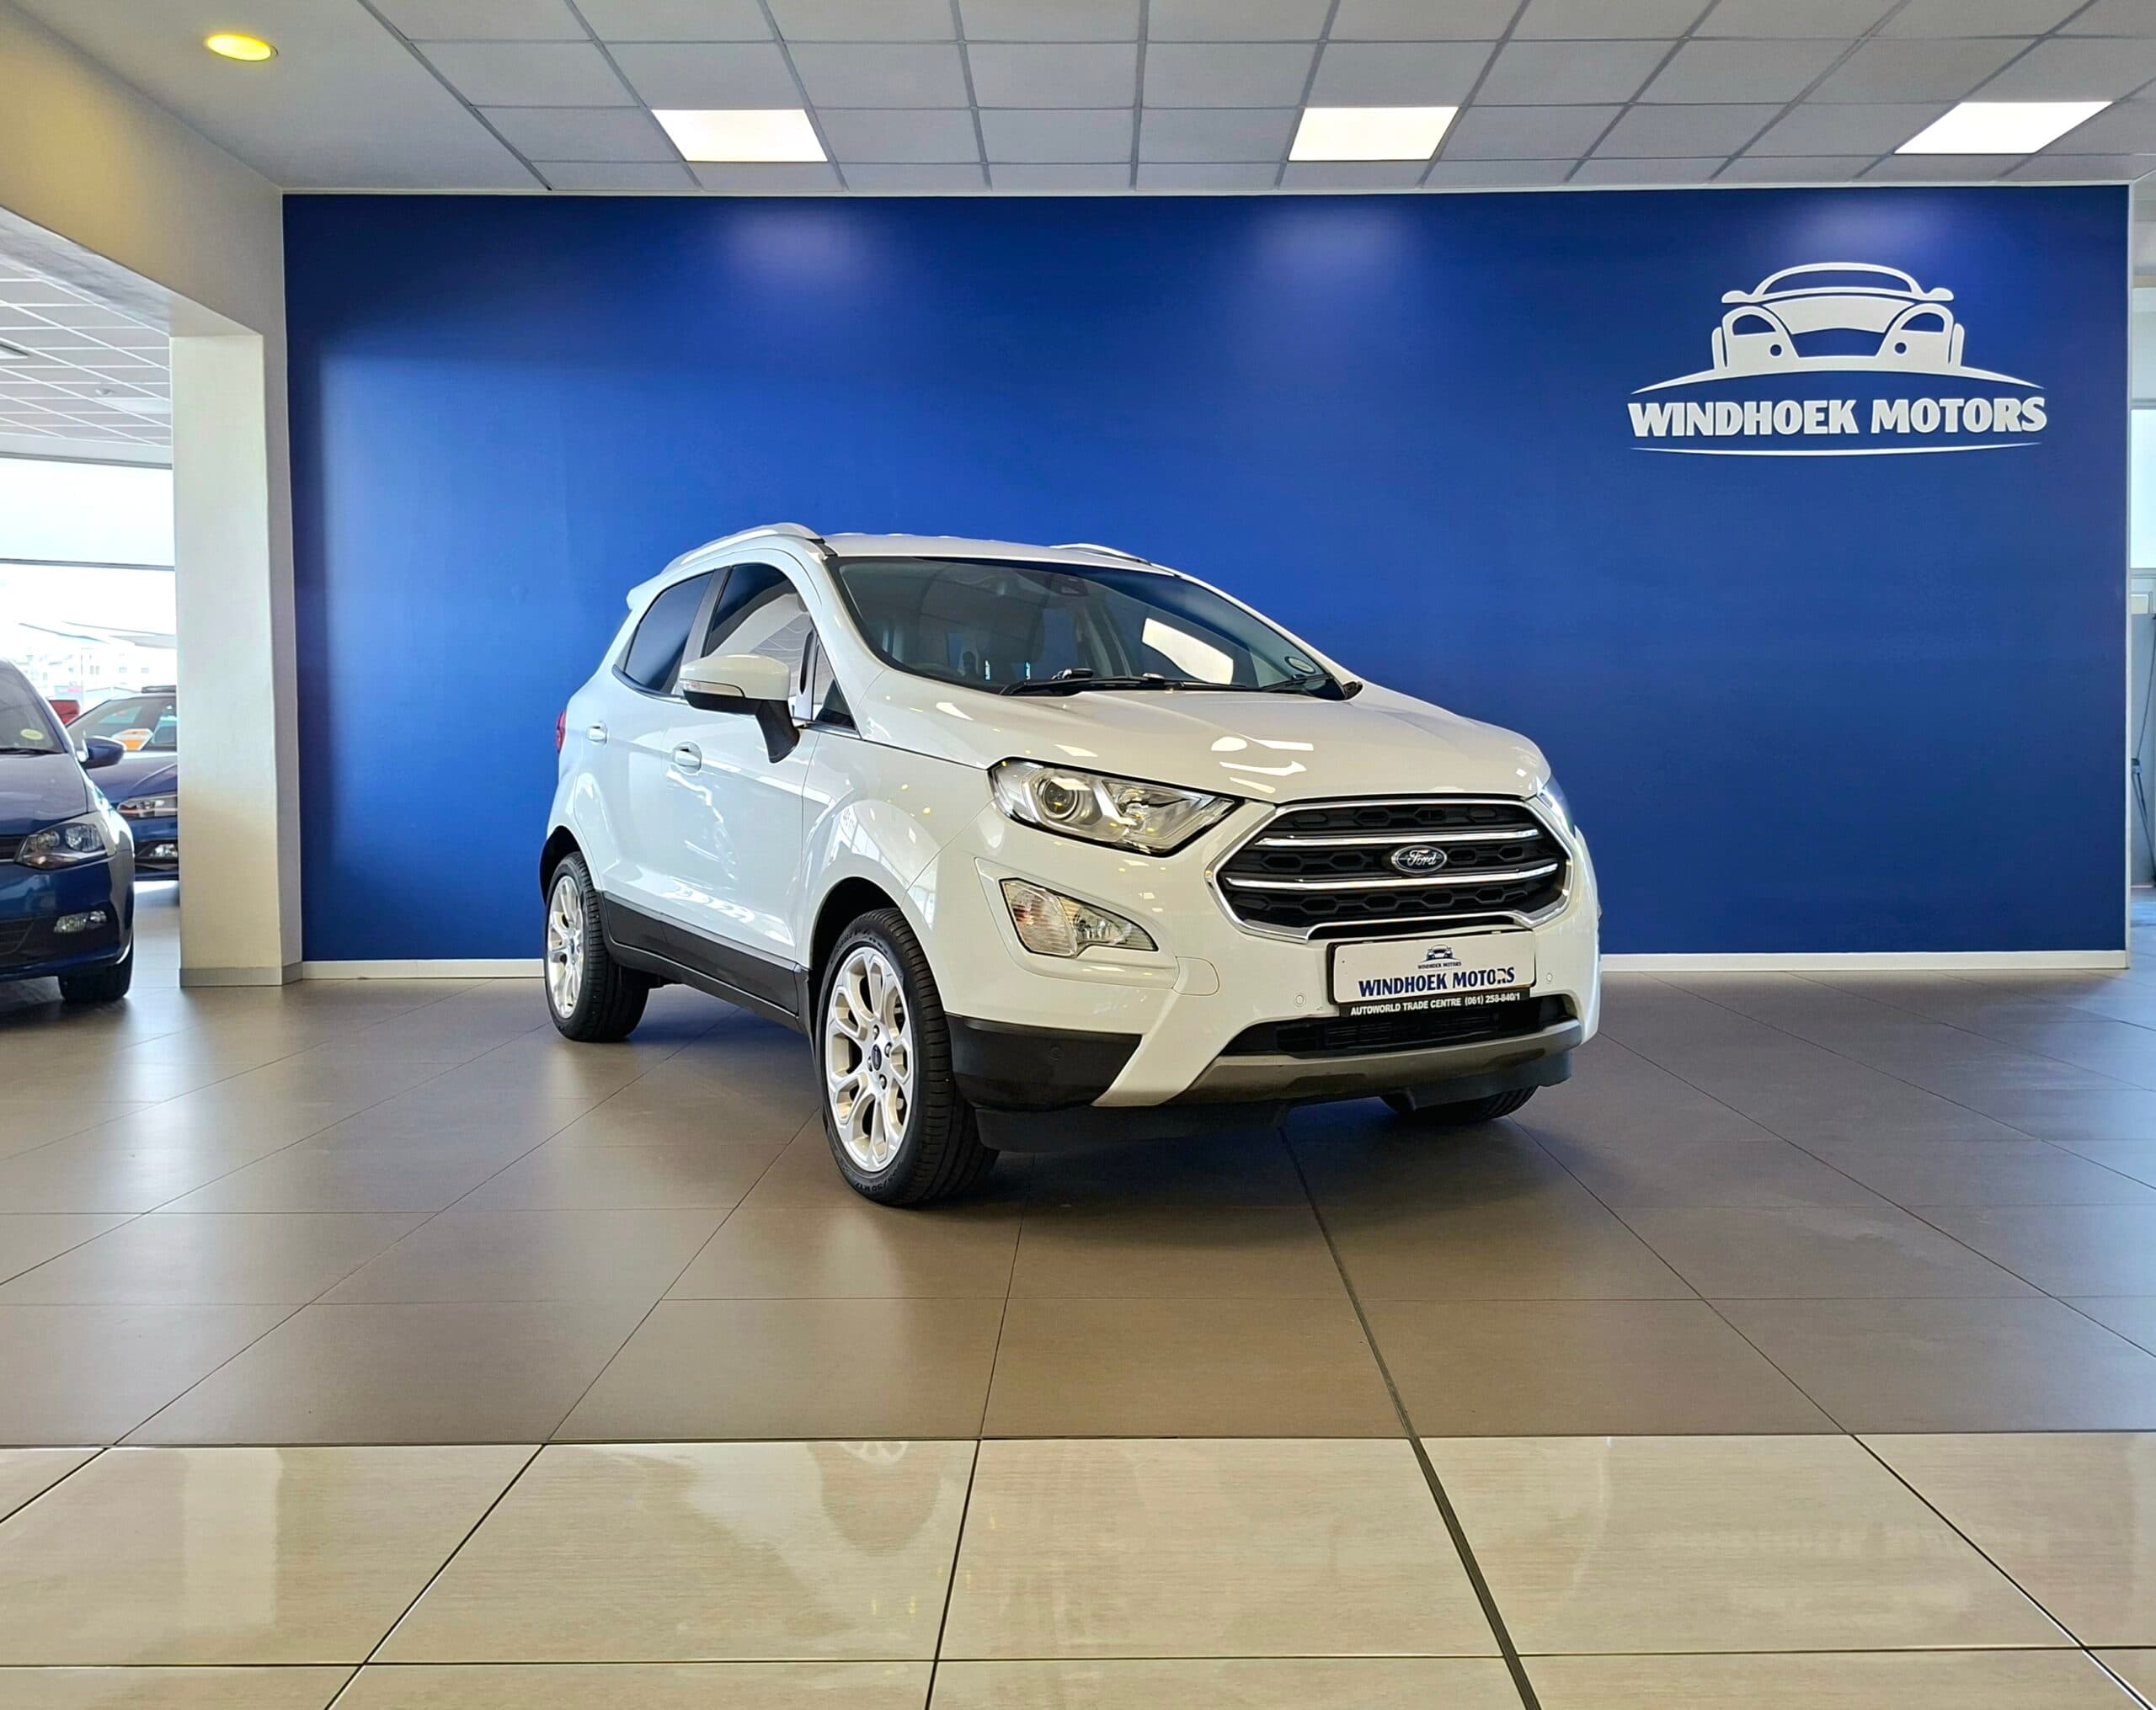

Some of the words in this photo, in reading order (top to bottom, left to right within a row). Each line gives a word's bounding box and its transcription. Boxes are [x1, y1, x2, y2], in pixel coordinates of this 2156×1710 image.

[1628, 399, 1860, 438] WINDHOEK
[1870, 397, 2047, 434] MOTORS
[1406, 849, 1437, 866] Ford
[1358, 973, 1447, 997] WINDHOEK
[1350, 1003, 1401, 1016] AUTOWORLD
[1402, 1000, 1429, 1011] TRADE
[1430, 997, 1462, 1009] CENTRE
[1465, 995, 1484, 1006] (061)
